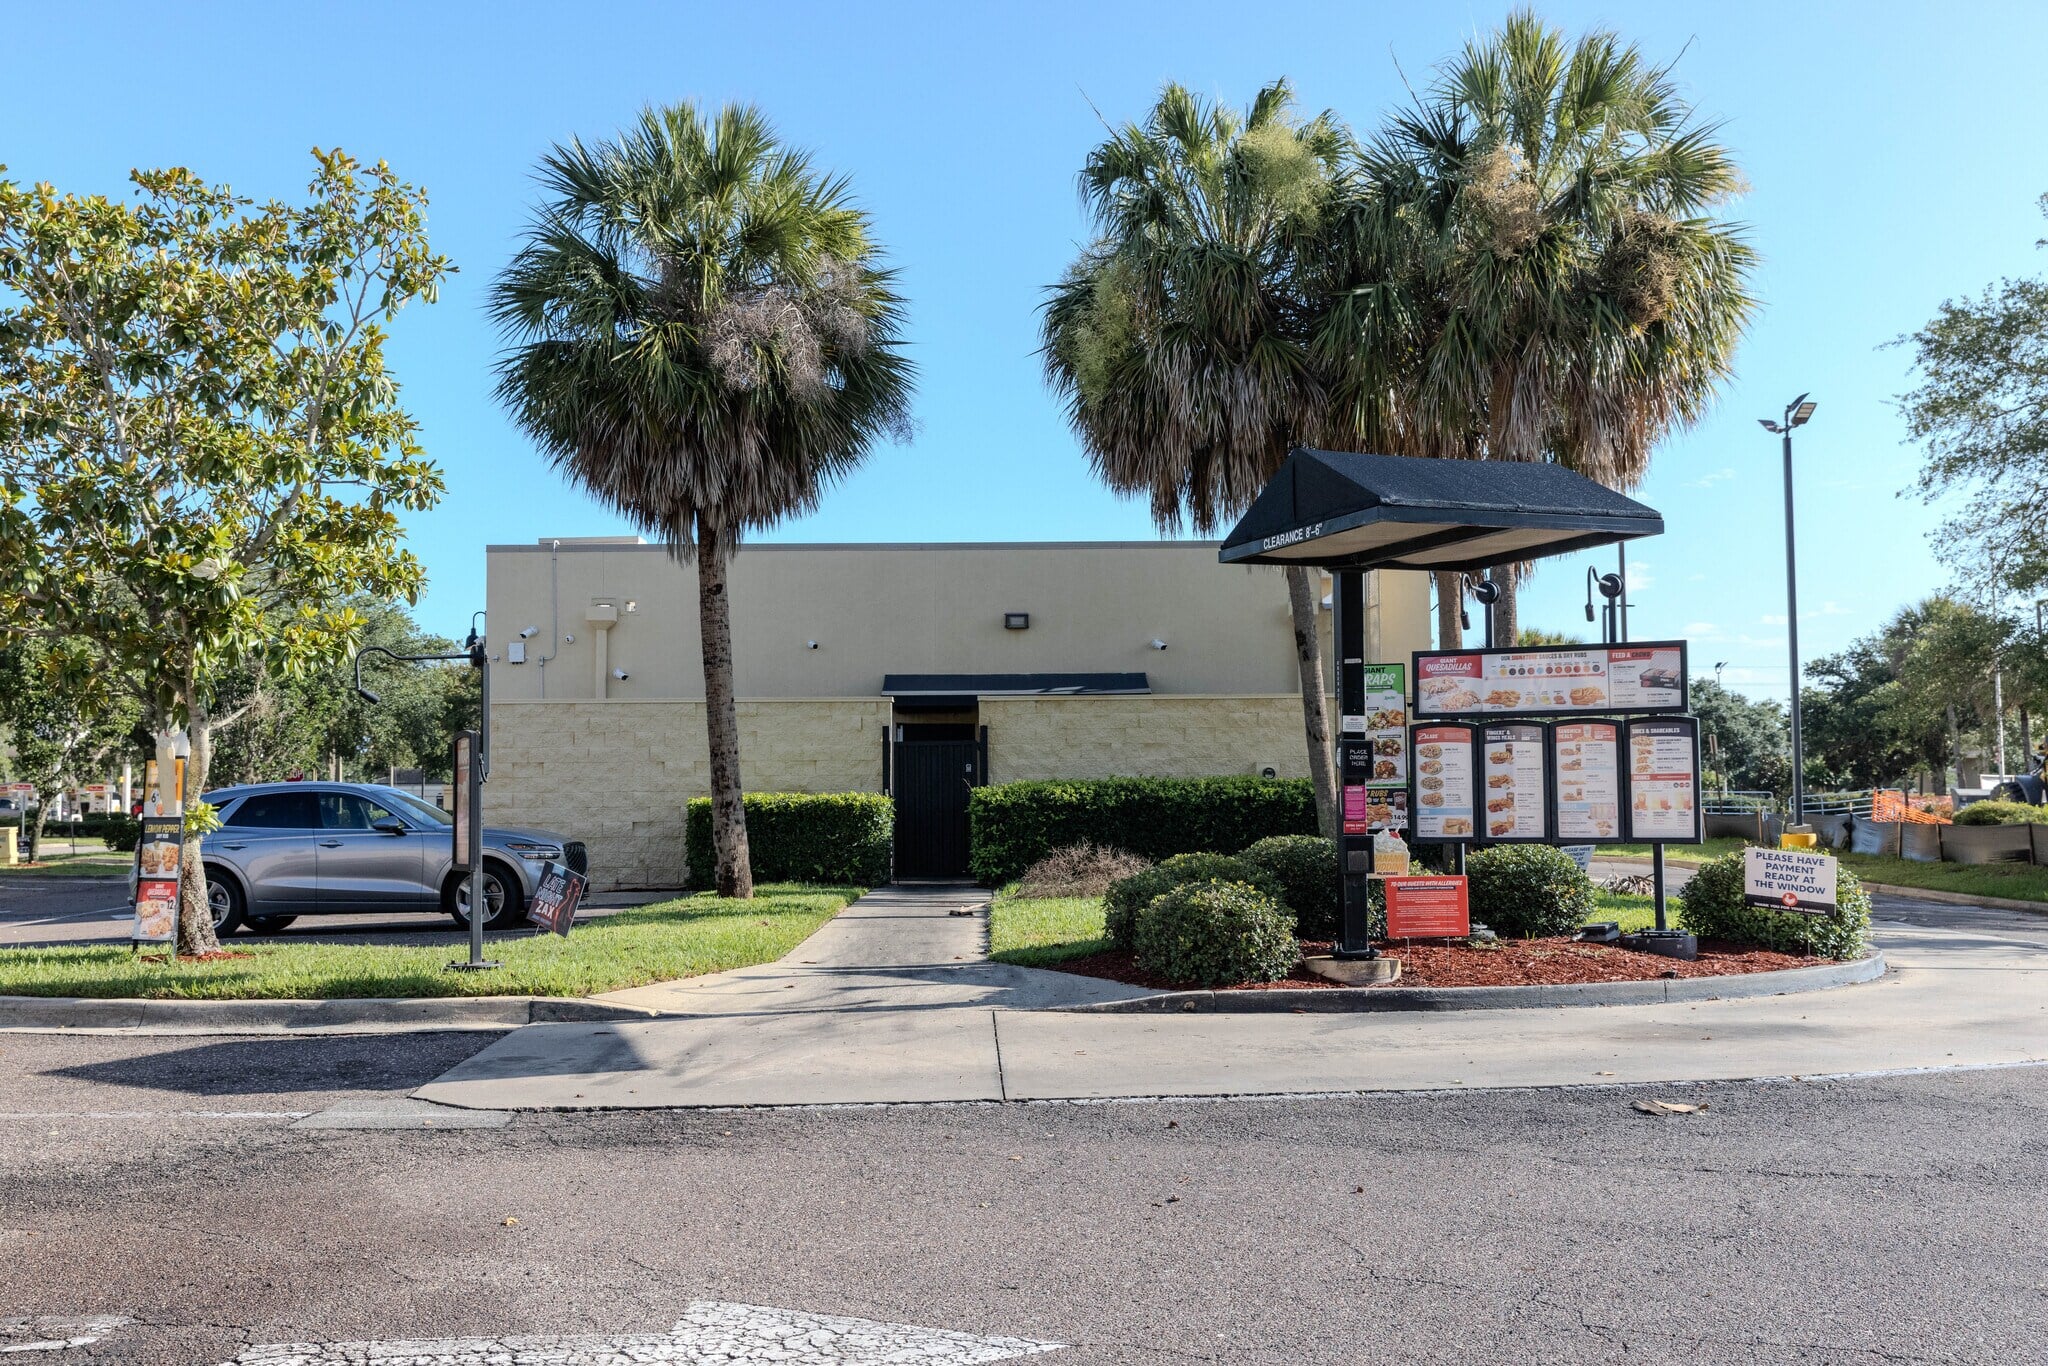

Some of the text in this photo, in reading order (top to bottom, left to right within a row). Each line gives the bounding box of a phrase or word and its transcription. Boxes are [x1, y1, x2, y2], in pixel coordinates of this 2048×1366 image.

[1263, 528, 1304, 550] CLEARANCE
[1426, 662, 1473, 672] QUESADILLAS
[1365, 673, 1396, 685] RAPS
[1370, 790, 1389, 798] RUBS
[145, 823, 180, 833] LEMON PEPPER
[1756, 851, 1825, 866] PLEASE HAVE
[1766, 862, 1815, 875] PAYMENT
[543, 873, 566, 894] LATE
[1765, 872, 1799, 882] READY
[1754, 880, 1826, 895] THE WINDOW
[535, 886, 564, 907] NIGHT
[535, 901, 555, 919] ZAX
